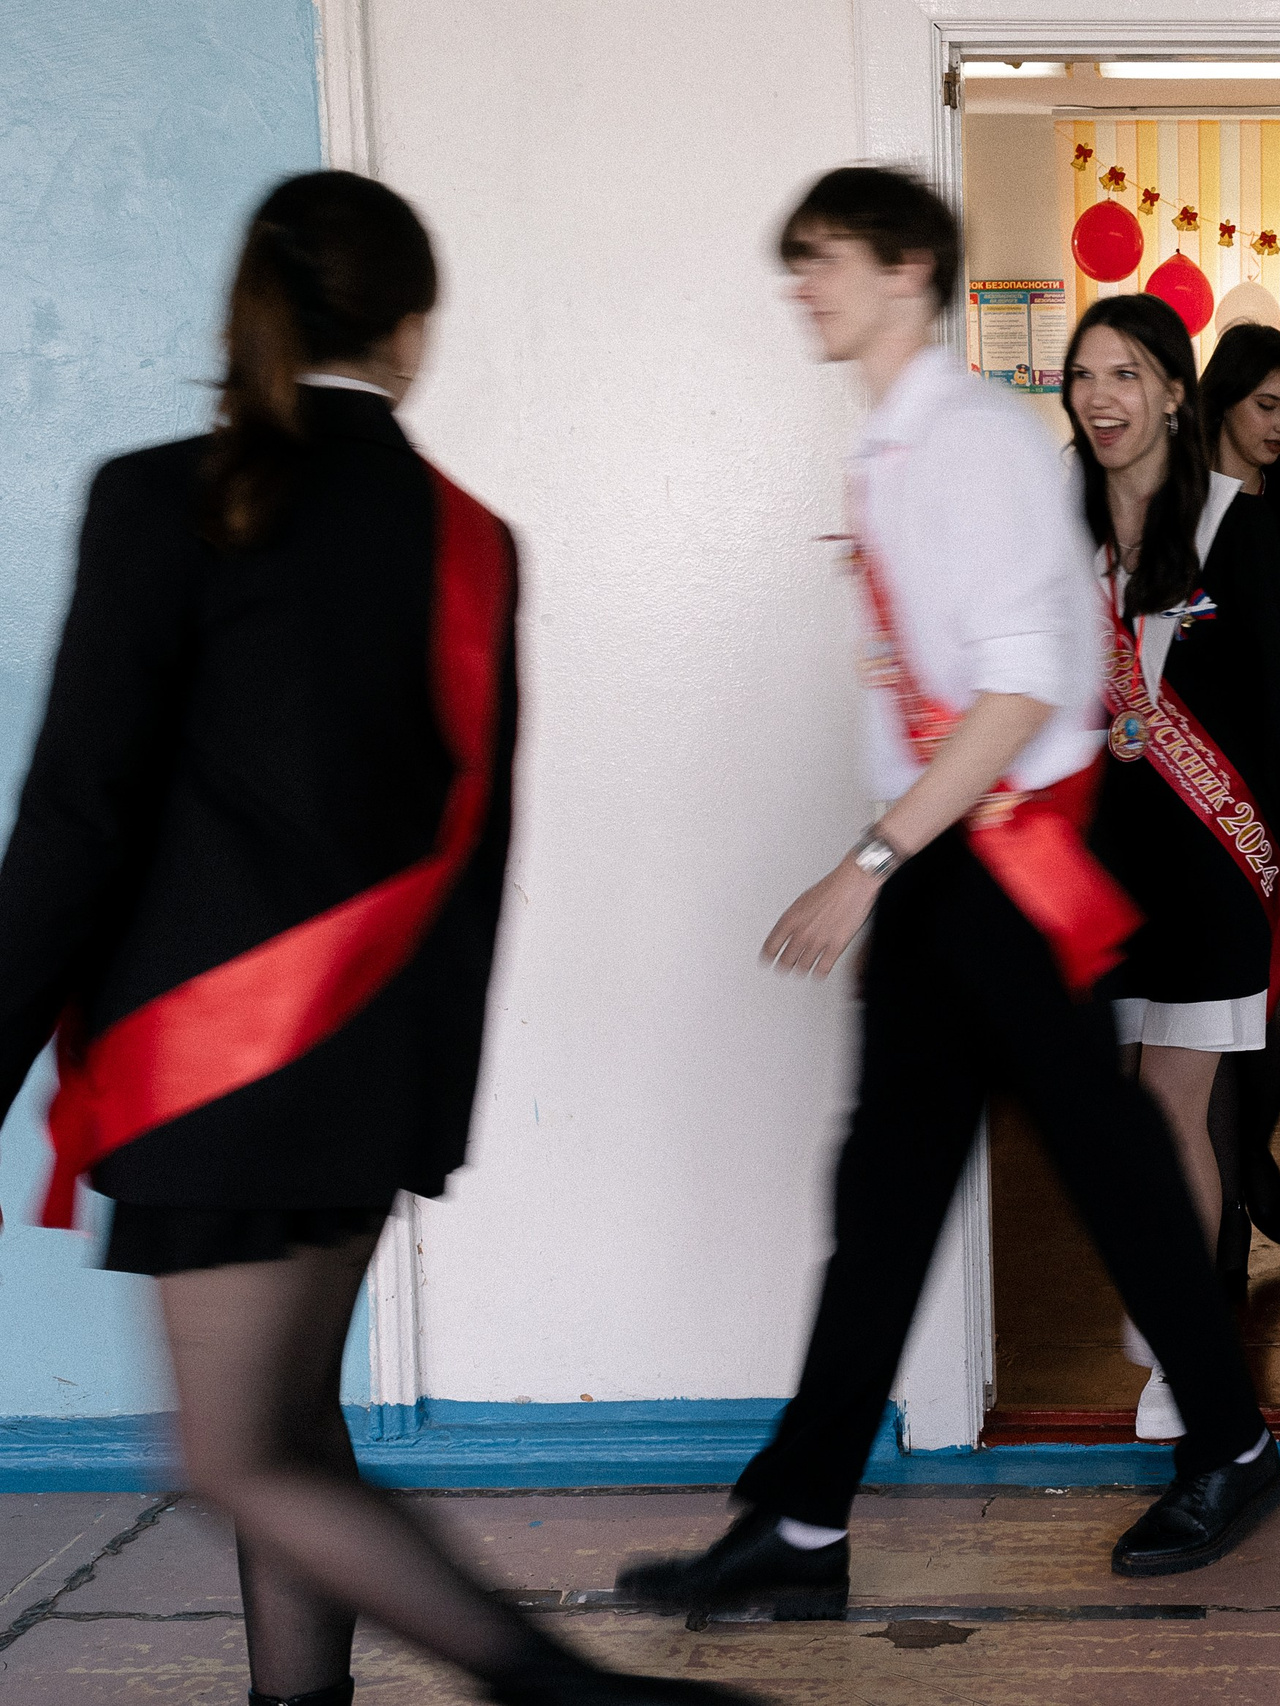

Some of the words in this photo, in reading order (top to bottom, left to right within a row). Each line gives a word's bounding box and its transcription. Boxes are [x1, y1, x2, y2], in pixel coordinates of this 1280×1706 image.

[970, 281, 984, 290] ОК
[985, 281, 1060, 290] БЕЗОПАСНОСТИ
[1217, 802, 1279, 897] 2024
